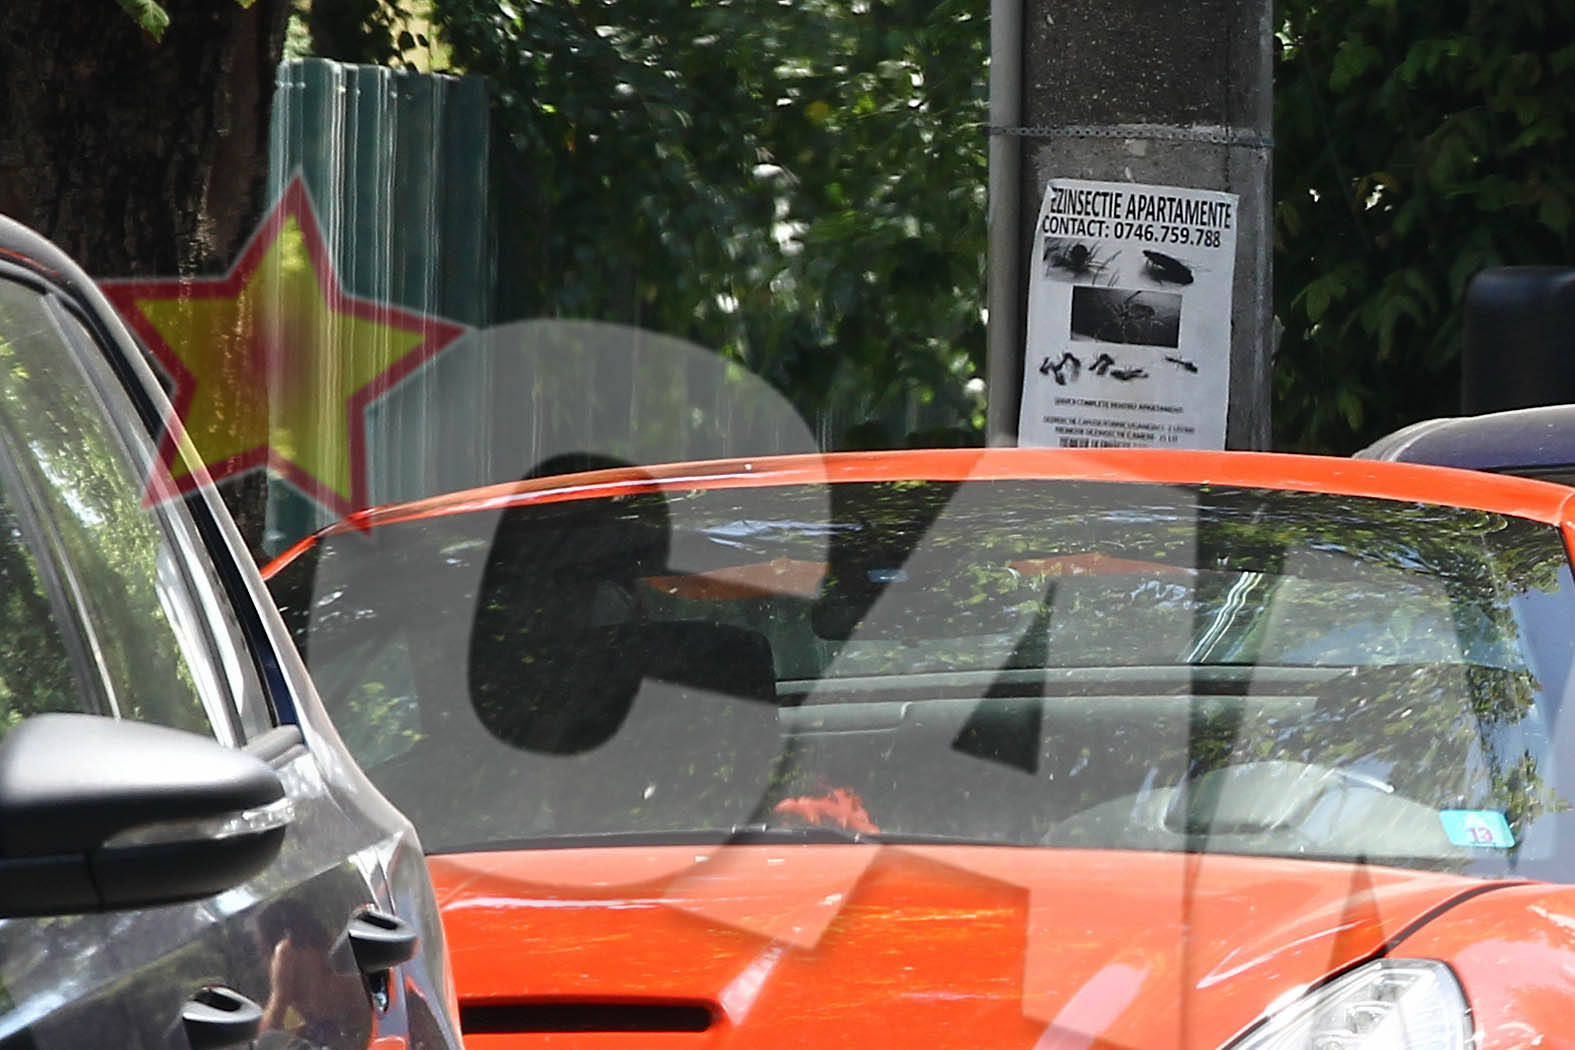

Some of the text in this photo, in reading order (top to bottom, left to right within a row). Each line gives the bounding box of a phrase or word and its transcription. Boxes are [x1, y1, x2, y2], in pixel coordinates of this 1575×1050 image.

[1125, 193, 1232, 229] APARTAMENTE
[1042, 215, 1221, 248] CONTACT: 0746.759.788
